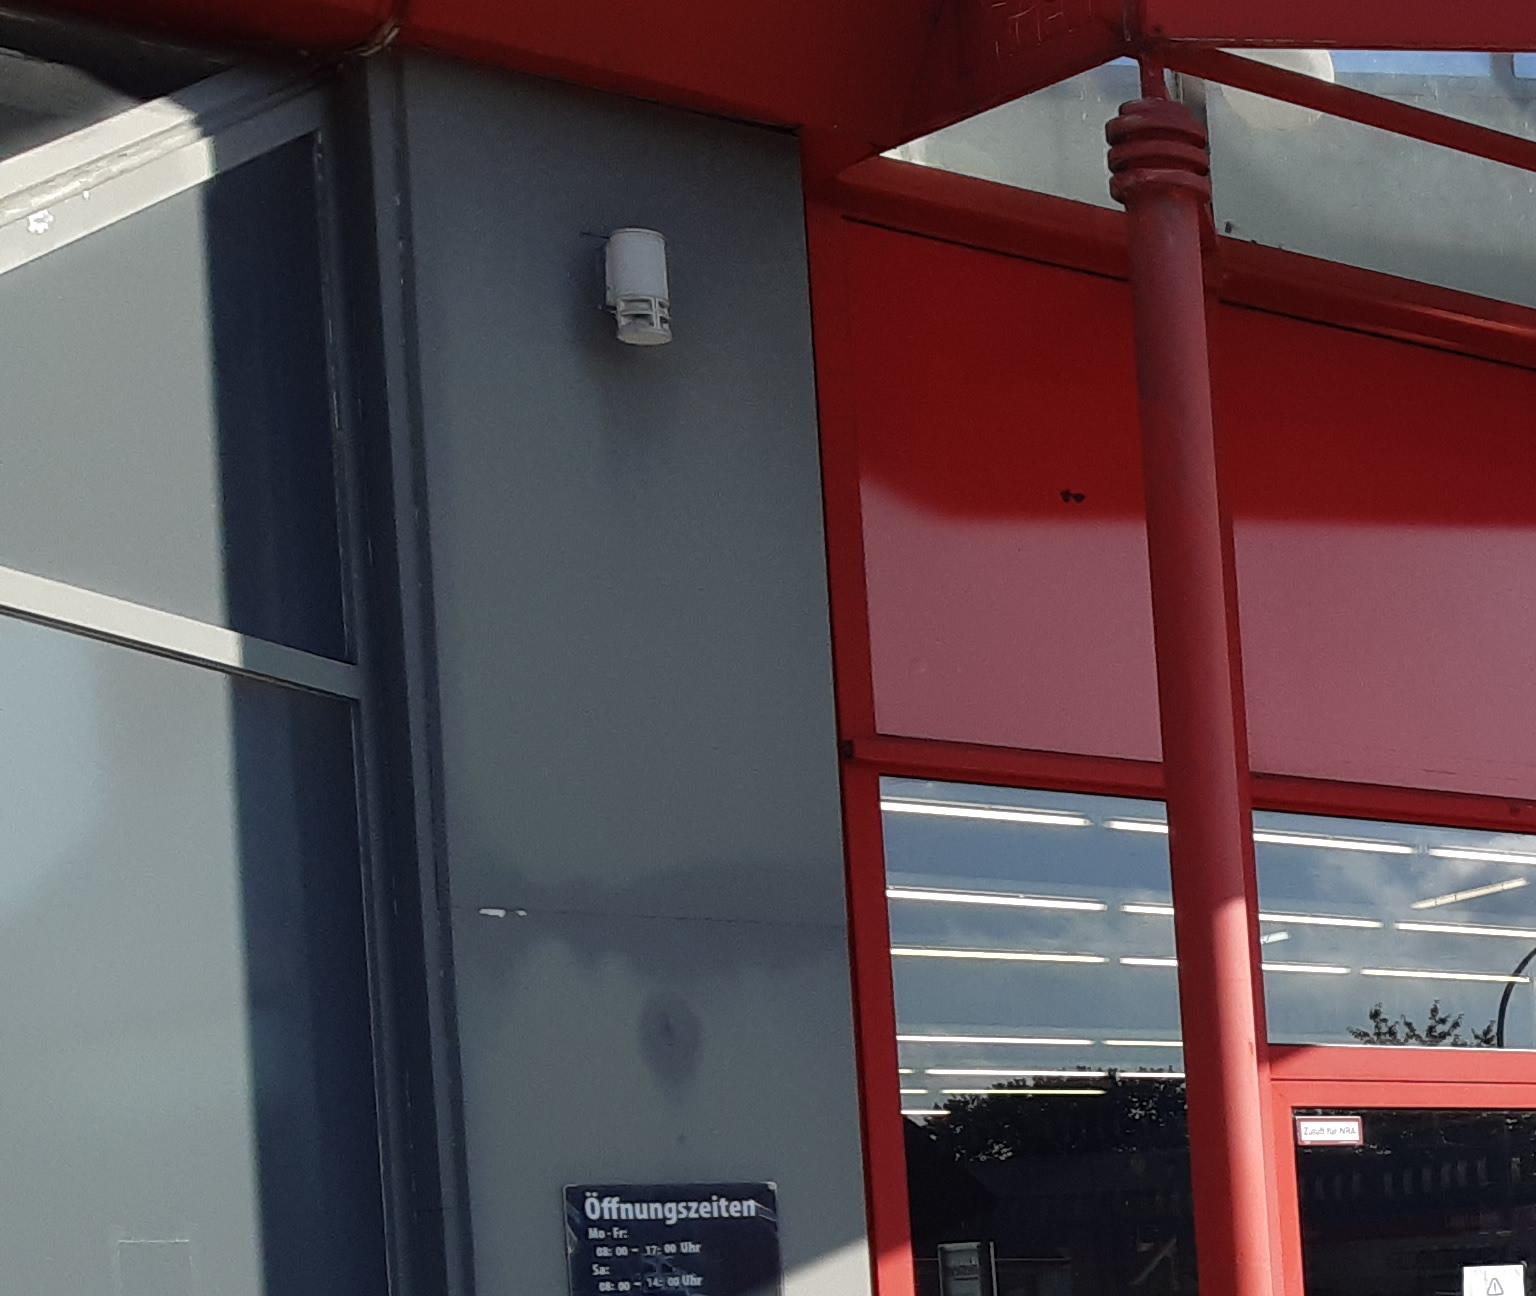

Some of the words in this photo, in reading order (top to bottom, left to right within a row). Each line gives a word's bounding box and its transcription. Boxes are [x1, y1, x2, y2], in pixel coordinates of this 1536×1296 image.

[584, 1191, 757, 1225] Öffnungszeiten
[680, 1241, 702, 1254] Uhr
[681, 1274, 704, 1286] Uhr
